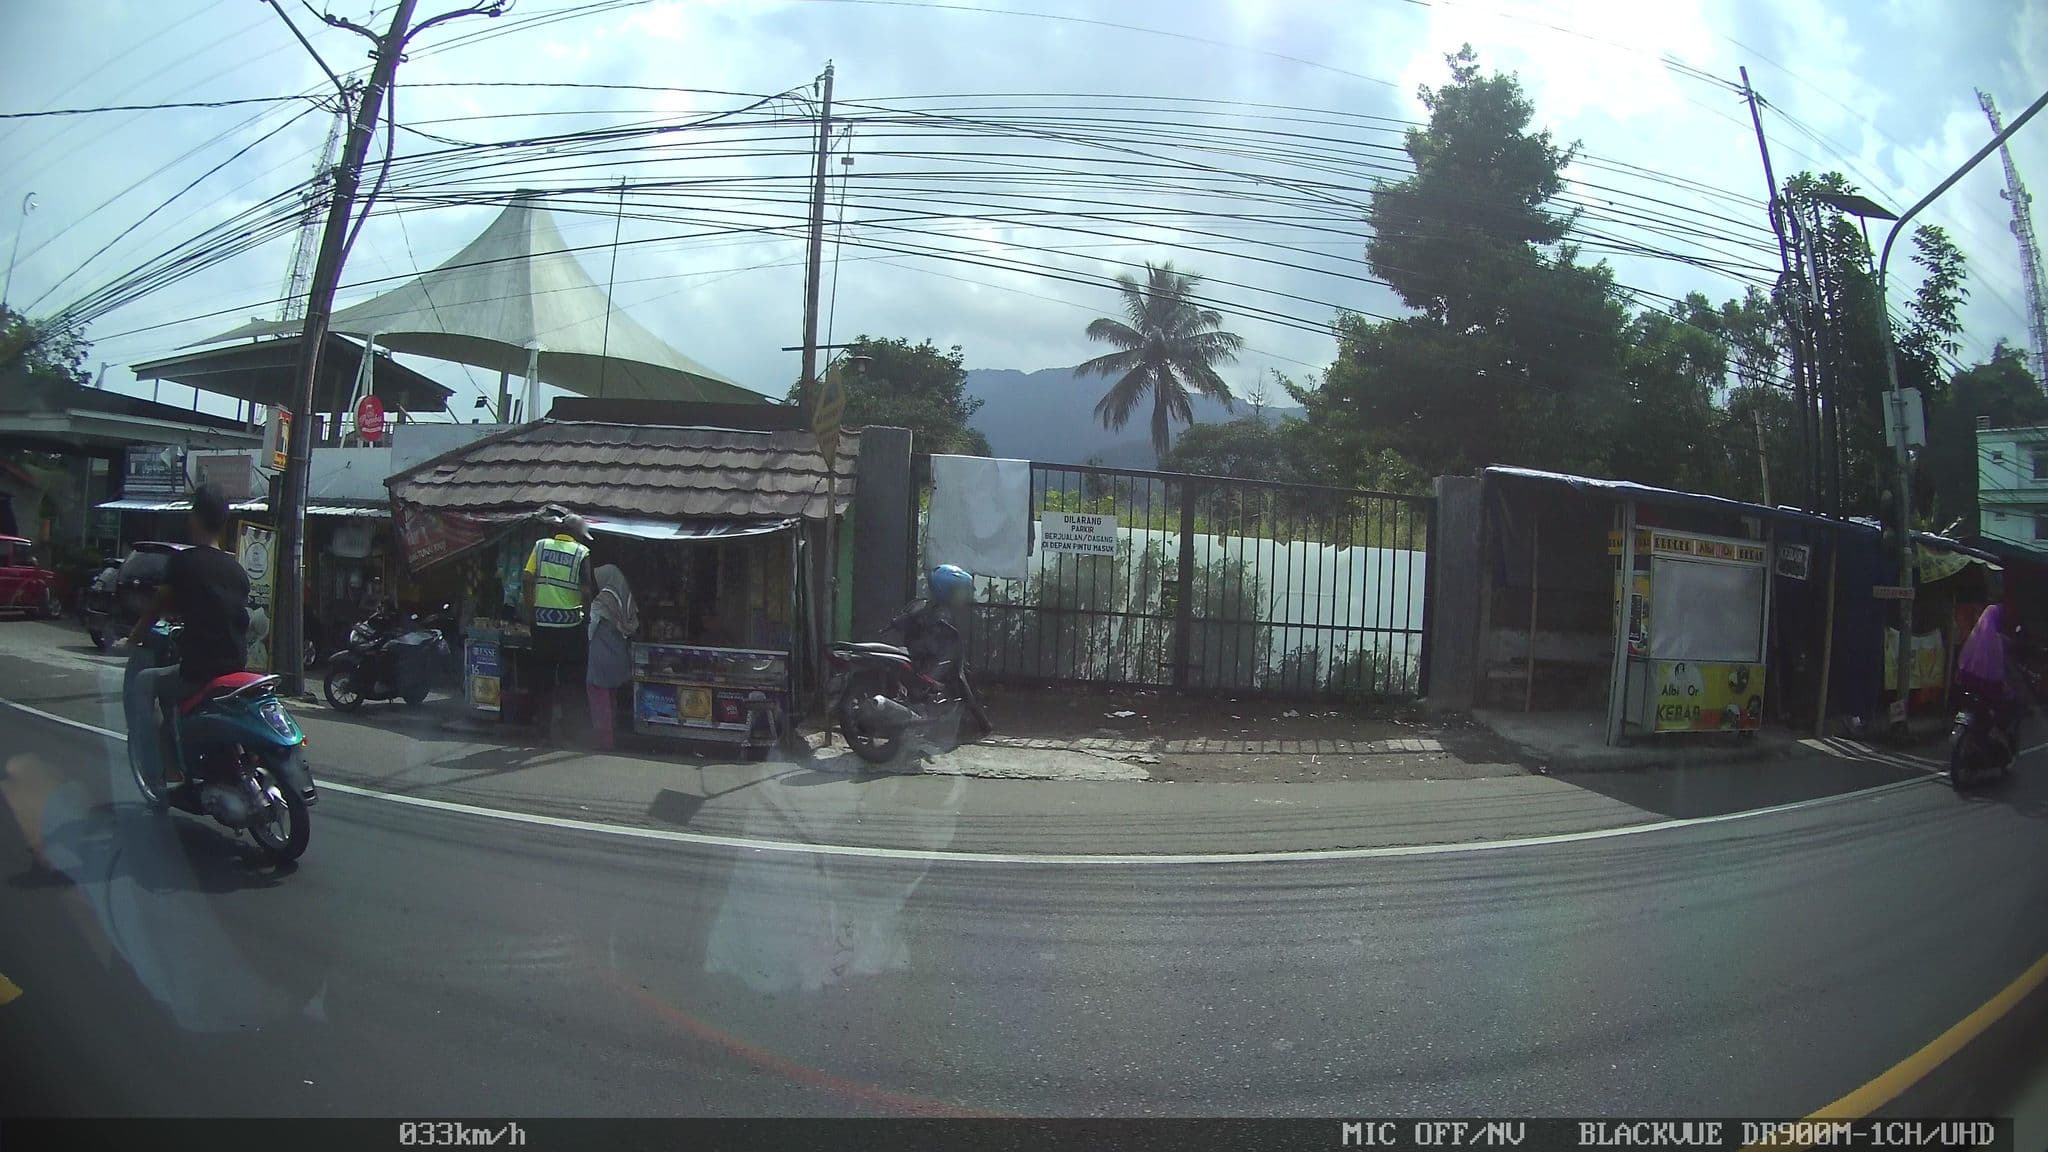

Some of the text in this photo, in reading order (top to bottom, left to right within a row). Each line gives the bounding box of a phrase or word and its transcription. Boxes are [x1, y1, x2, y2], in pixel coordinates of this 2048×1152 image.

[1064, 515, 1102, 525] DILARANG
[1071, 525, 1095, 533] PARKIR
[1050, 542, 1071, 550] DEPAN
[1073, 543, 1092, 551] PINTU
[1093, 544, 1114, 553] MASUK
[543, 550, 574, 566] POLISI
[1661, 684, 1680, 697] Albi
[1656, 703, 1700, 721] KEBAB
